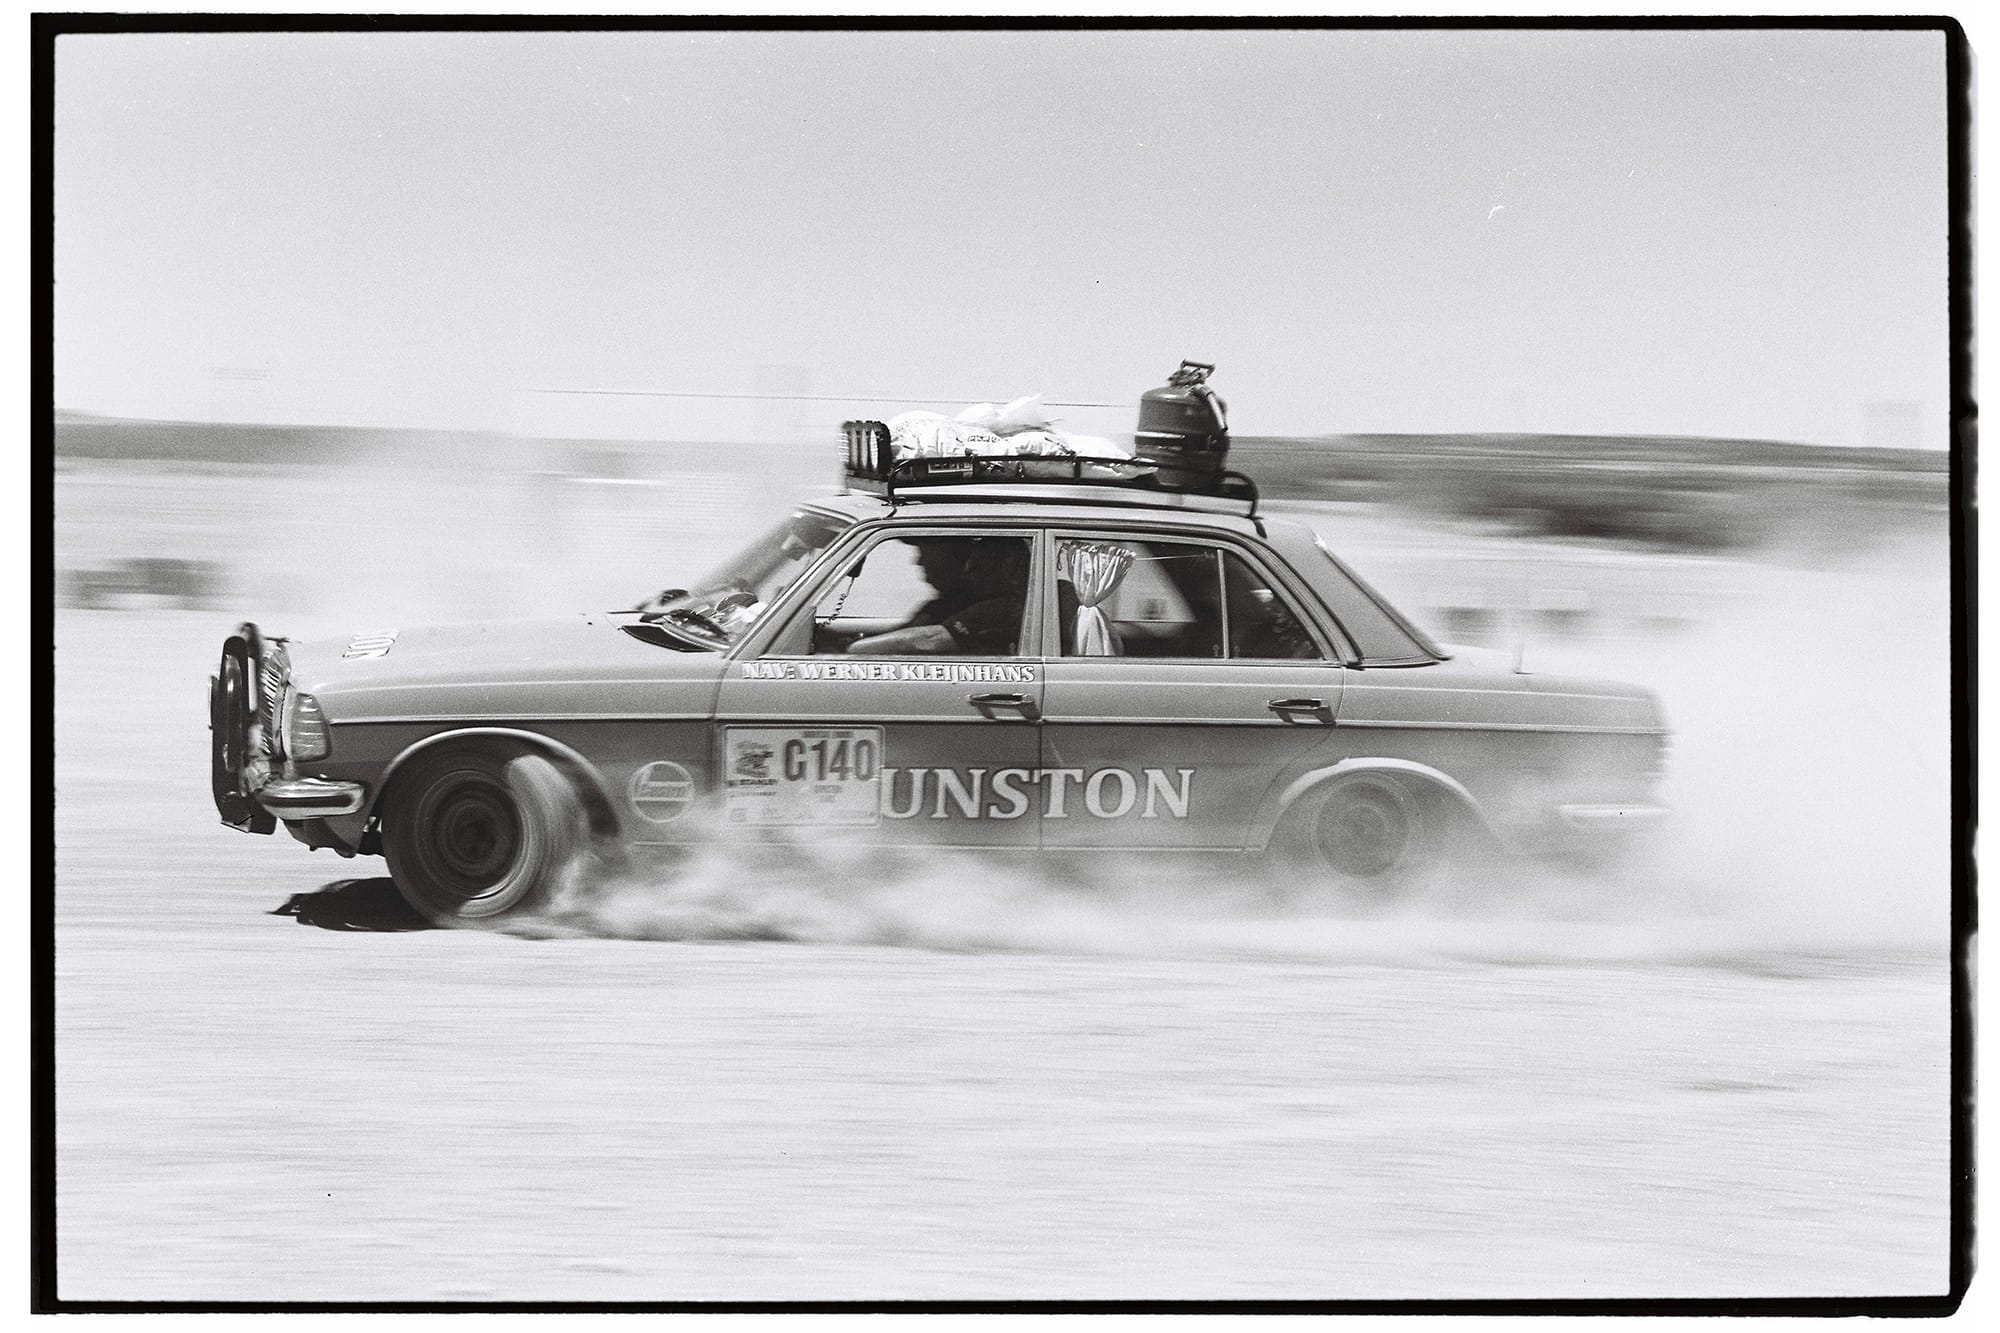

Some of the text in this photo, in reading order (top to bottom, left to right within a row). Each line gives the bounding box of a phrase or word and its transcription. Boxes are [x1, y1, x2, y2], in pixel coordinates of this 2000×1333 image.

[741, 661, 1035, 684] NAV: WERNER KLEIJNHANS
